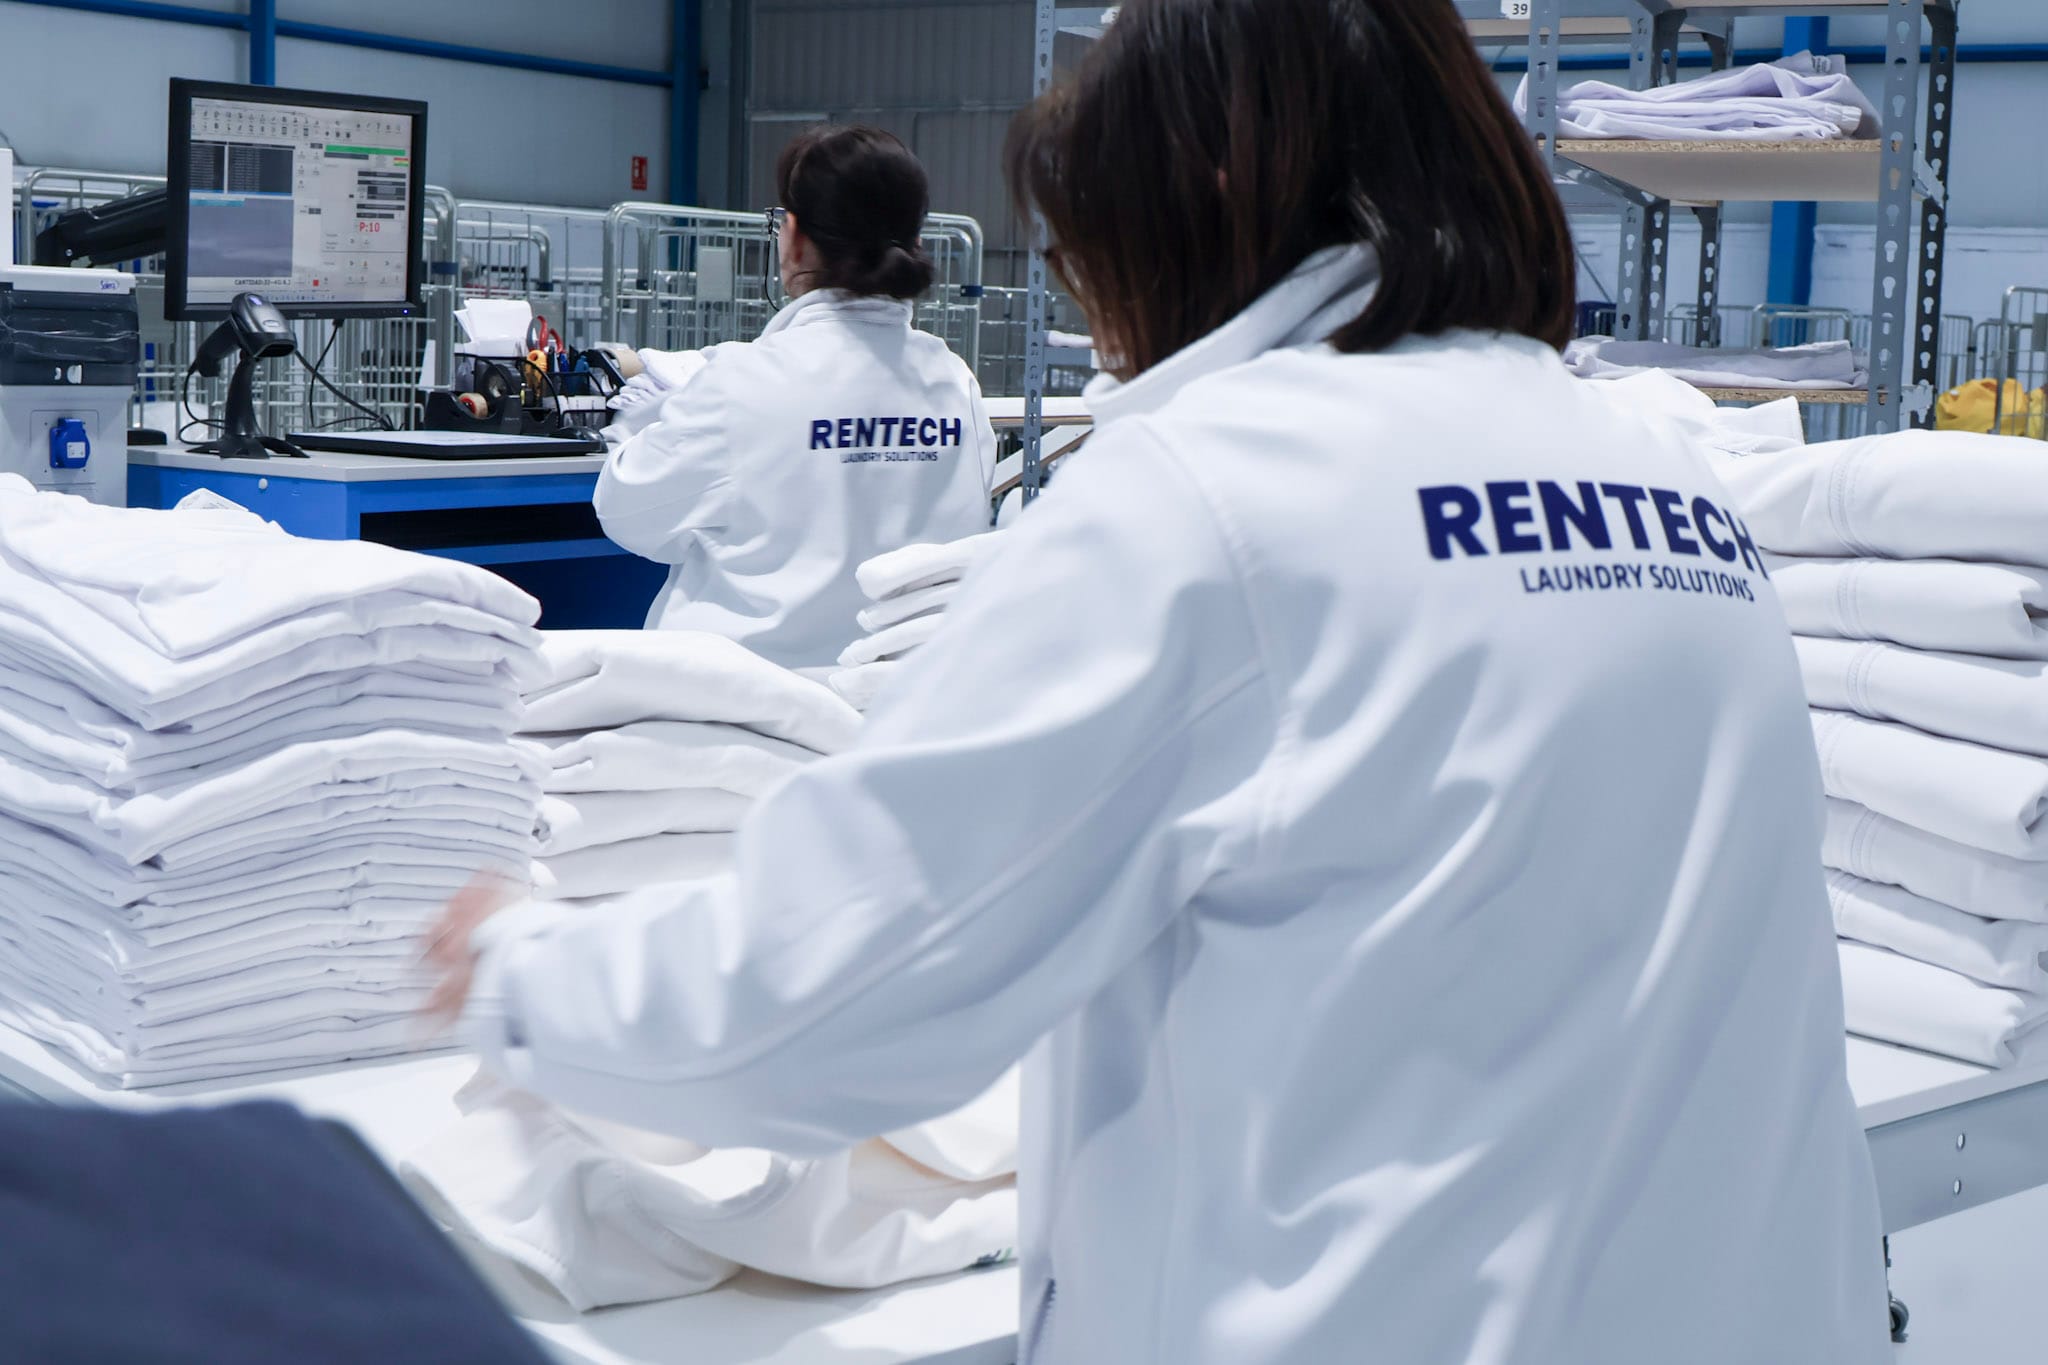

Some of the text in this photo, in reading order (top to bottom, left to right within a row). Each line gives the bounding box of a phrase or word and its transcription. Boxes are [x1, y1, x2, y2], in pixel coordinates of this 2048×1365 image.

[1512, 3, 1528, 15] 39
[359, 222, 380, 232] P:10
[810, 417, 961, 449] RENTECH
[884, 451, 938, 462] SOLUTIONS
[1417, 480, 1769, 581] RENTECH
[1520, 563, 1754, 602] LAUNDRY SOLUTIONS
